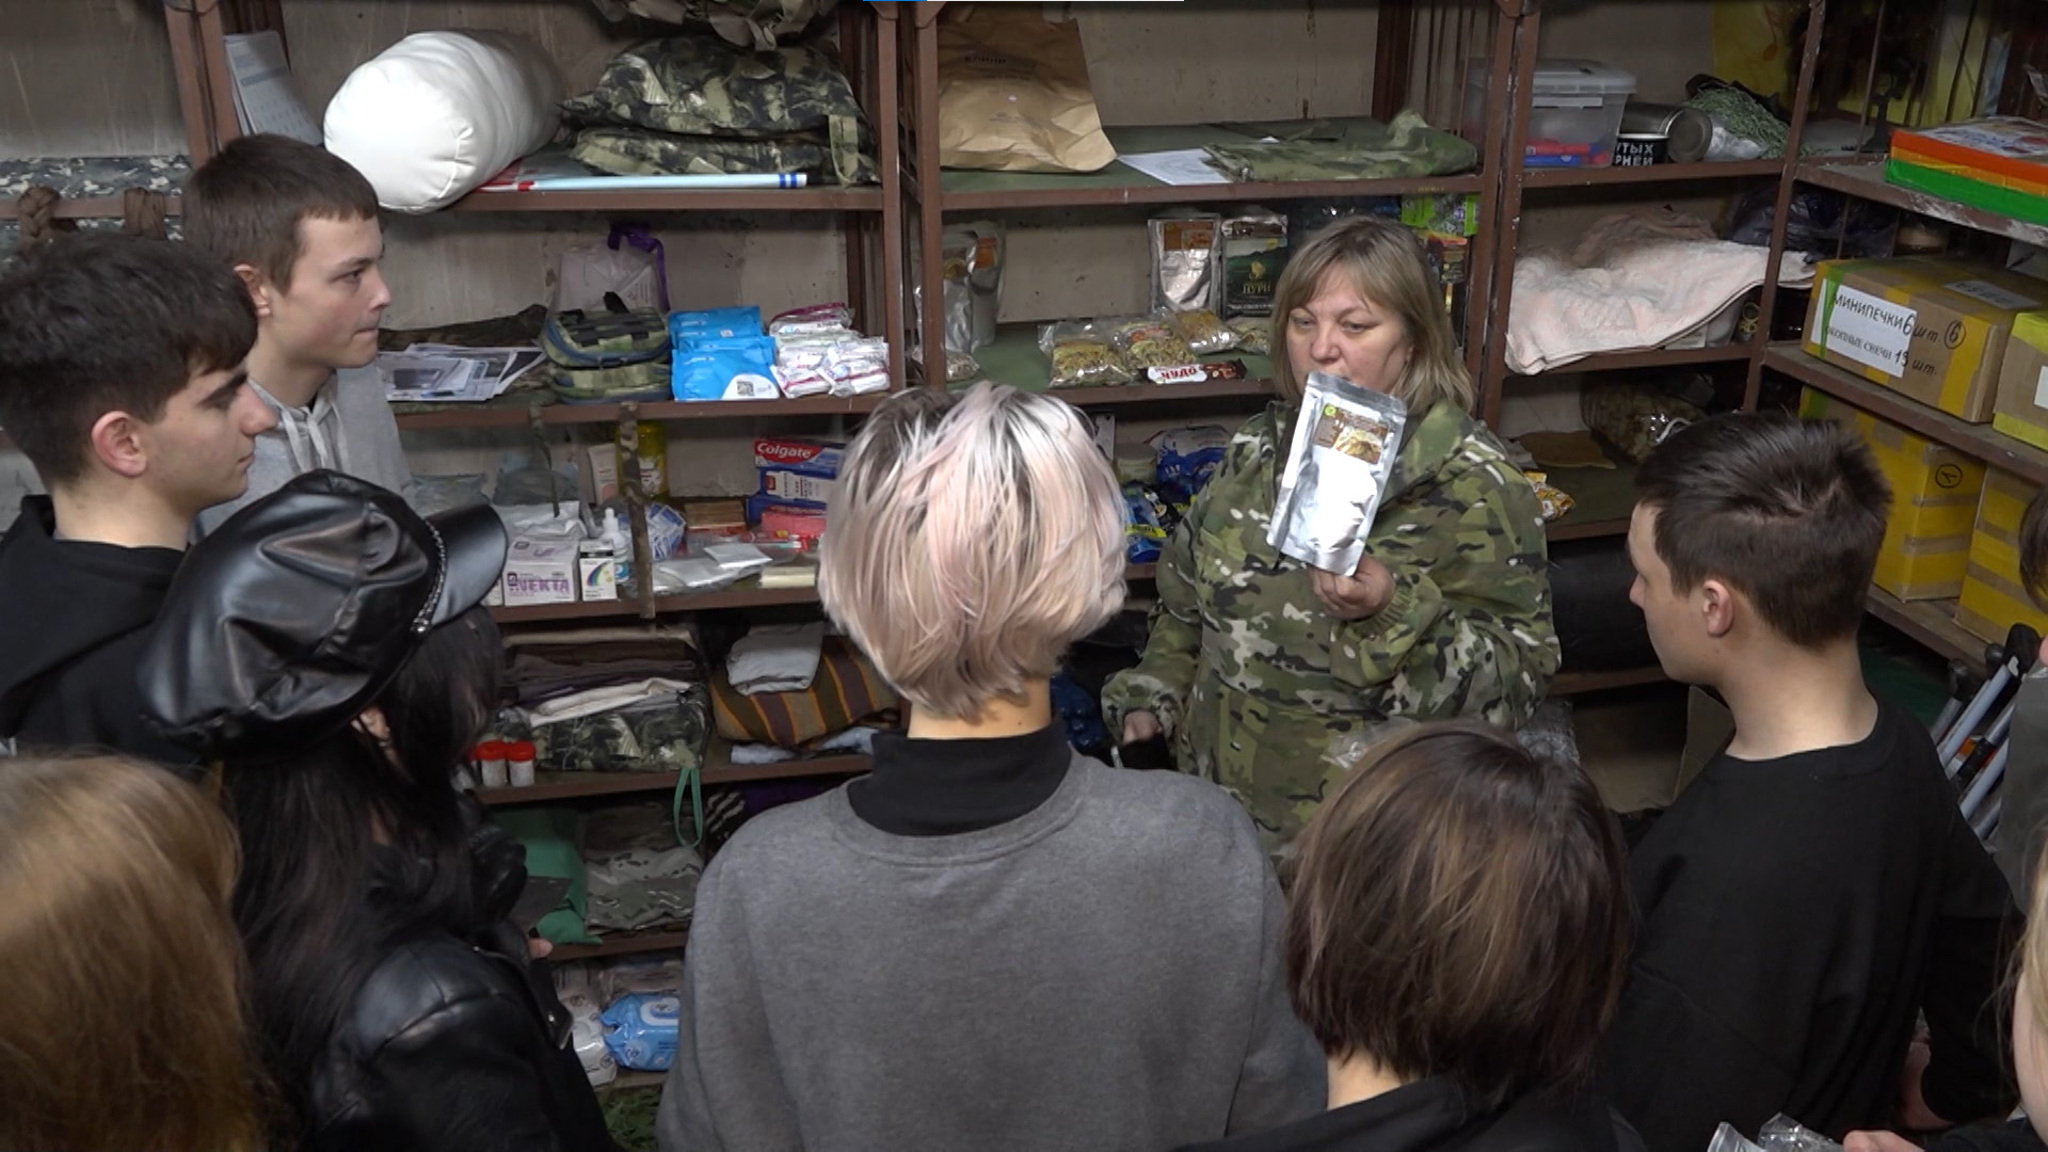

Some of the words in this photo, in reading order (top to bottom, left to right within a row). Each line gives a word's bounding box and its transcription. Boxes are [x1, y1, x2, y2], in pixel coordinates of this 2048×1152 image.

[1827, 326, 1862, 348] КОПНЫЕ
[1161, 366, 1197, 379] ЧУДО
[757, 443, 812, 458] Colgate
